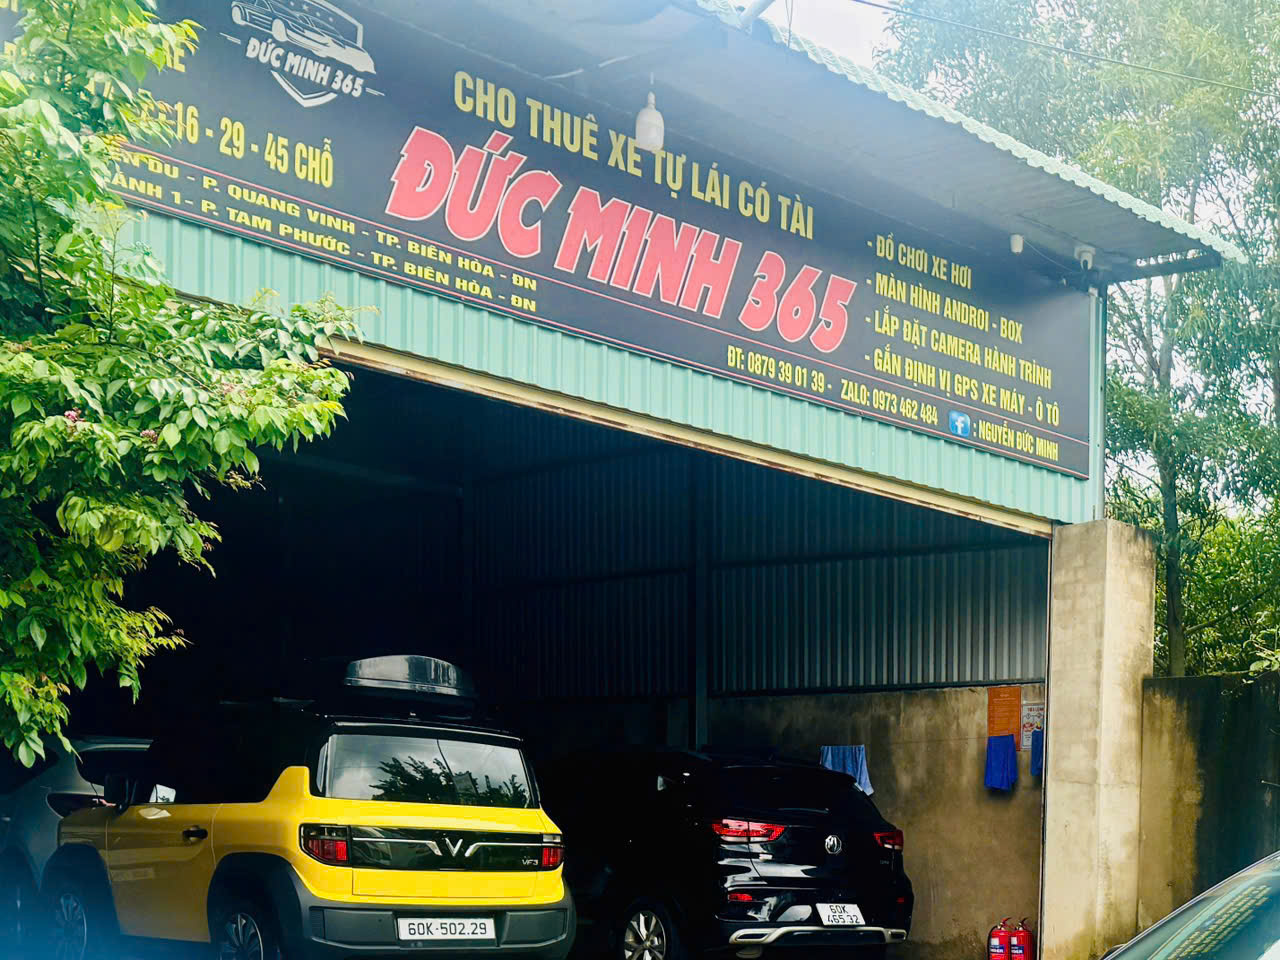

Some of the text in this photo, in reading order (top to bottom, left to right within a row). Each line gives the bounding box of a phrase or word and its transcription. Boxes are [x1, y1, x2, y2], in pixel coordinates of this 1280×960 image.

[246, 37, 365, 97] ĐỨC MINH 365
[219, 117, 245, 160] 29
[264, 132, 288, 174] 45
[294, 138, 333, 188] CHỖ
[454, 71, 813, 240] CHO THUÊ XE TỰ LÁI CÓ TÀI
[201, 200, 219, 216] P.
[225, 207, 272, 232] TAM
[279, 223, 350, 255] PHƯỚC
[371, 252, 397, 270] TP.
[404, 261, 449, 286] BIÊN
[456, 277, 492, 299] HÒA
[511, 295, 536, 312] ĐN
[203, 176, 220, 192] P.
[227, 184, 300, 217] QUANG
[306, 209, 355, 234] VINH
[375, 230, 401, 248] TP.
[407, 240, 452, 264] BIÊN
[458, 255, 494, 278] HÒA
[511, 273, 537, 291] ĐN
[385, 125, 857, 353] ĐỨC MINH 365
[876, 232, 895, 261] ĐỒ
[898, 242, 928, 273] CHƠI
[932, 255, 948, 280] XE
[951, 262, 972, 289] HƠI
[876, 272, 906, 303] MÀN
[910, 284, 940, 316] HÌNH
[944, 297, 990, 332] ANDROI
[1000, 317, 1023, 344] BOX
[727, 345, 744, 370] ĐT:
[748, 351, 775, 379] 0879
[778, 362, 793, 387] 39
[795, 366, 807, 388] 01
[811, 371, 825, 393] 39
[874, 305, 899, 337] LẮP
[903, 319, 927, 350] ĐẶT
[931, 329, 981, 366] CAMERA
[984, 346, 1016, 378] HÀNH
[1018, 359, 1052, 390] TRÌNH
[841, 379, 938, 426] ZALO: 0973 462 484
[874, 343, 901, 377] GẮN
[905, 357, 936, 388] ĐỊNH
[939, 368, 951, 397] VỊ
[954, 374, 978, 400] GPS
[981, 382, 997, 406] XE
[1000, 388, 1025, 415] MÁY
[1046, 401, 1059, 427] TÔ
[979, 420, 1014, 449] NGUYỄN
[1016, 430, 1034, 454] ĐỨC
[1036, 437, 1059, 461] MINH
[408, 922, 487, 935] 60K-502.29
